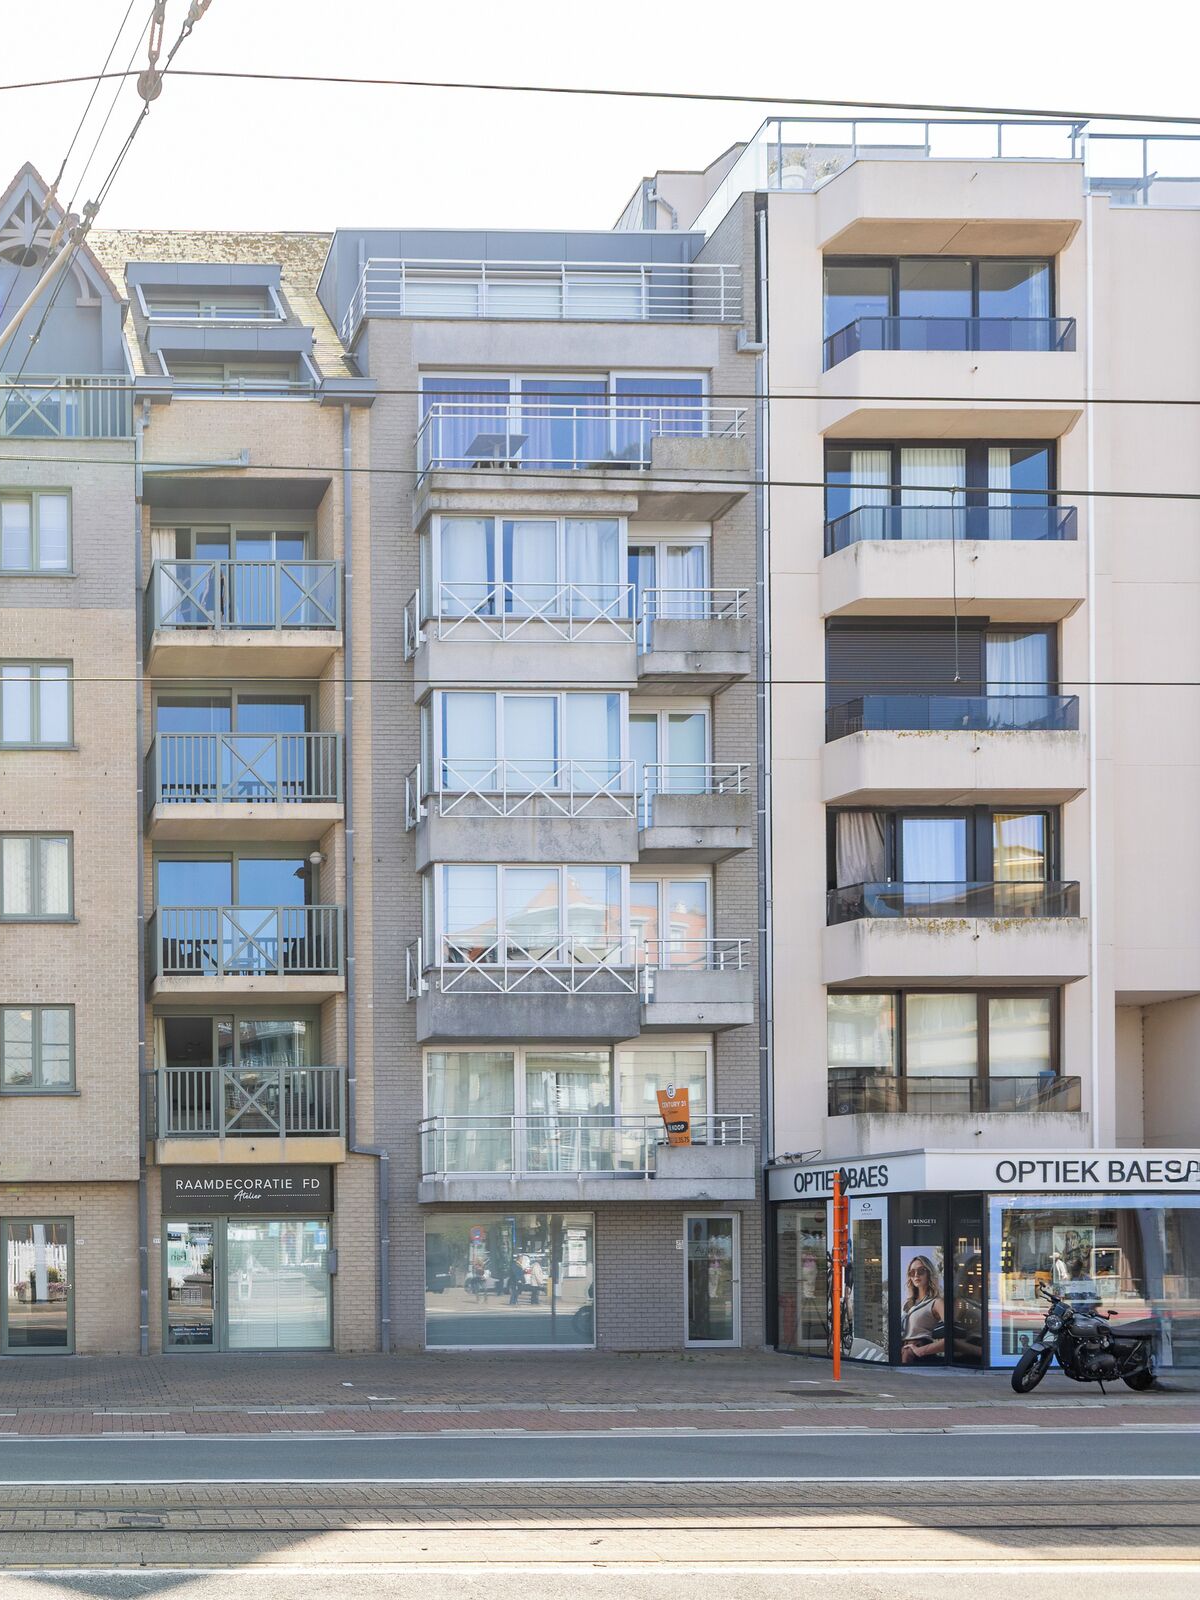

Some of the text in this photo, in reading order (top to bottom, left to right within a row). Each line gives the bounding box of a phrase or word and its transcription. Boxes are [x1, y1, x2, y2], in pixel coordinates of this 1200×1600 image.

[793, 1164, 889, 1193] OPTIE BAES
[995, 1160, 1099, 1184] OPTIEK
[175, 1178, 321, 1190] RAAMDECORATIE FD
[233, 1189, 262, 1202] Atelier
